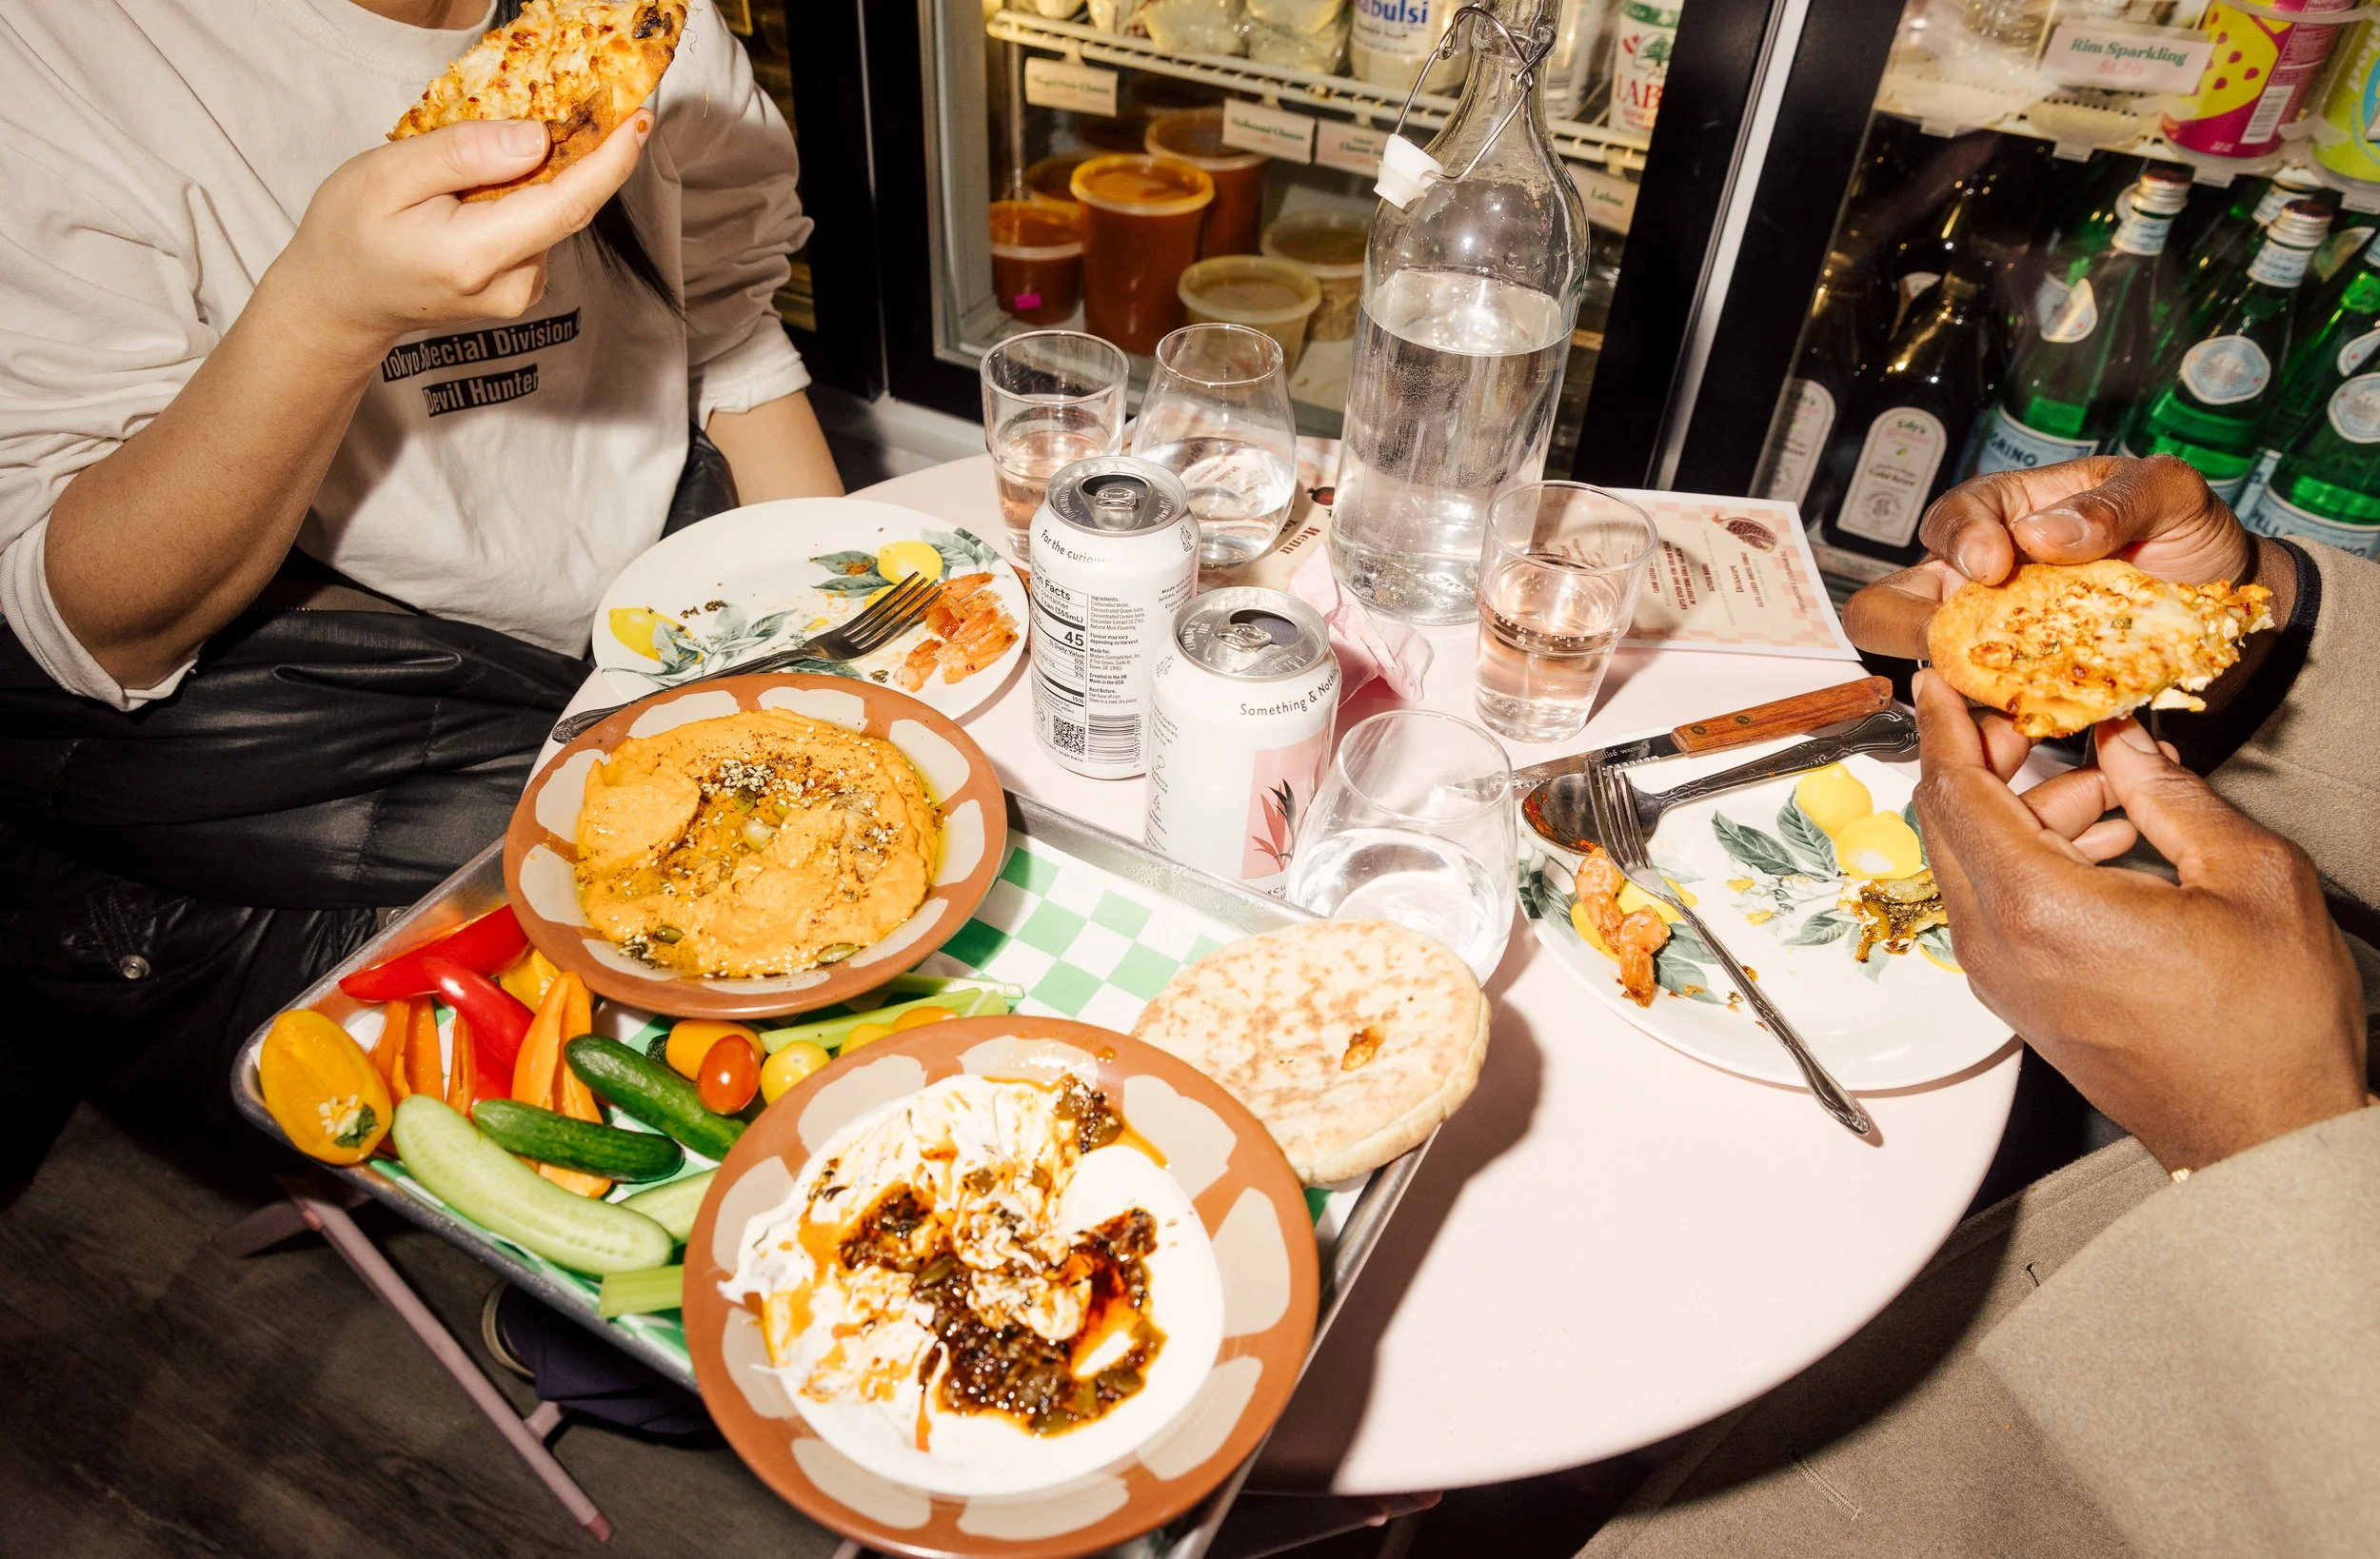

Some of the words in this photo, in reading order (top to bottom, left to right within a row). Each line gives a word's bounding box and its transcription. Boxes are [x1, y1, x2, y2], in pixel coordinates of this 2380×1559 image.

[1358, 0, 1428, 23] abulsi
[2071, 38, 2103, 53] Rim
[2106, 42, 2189, 67] Sparkling
[384, 348, 420, 379] Tokyo
[492, 319, 573, 356] Division
[424, 383, 466, 415] Devil
[468, 369, 539, 405] Hunter
[1041, 529, 1052, 545] For
[1052, 541, 1065, 555] the
[1045, 579, 1070, 601] Facts
[1055, 606, 1083, 623] (355mL)
[1054, 642, 1067, 654] Daily
[1068, 649, 1084, 659] Value
[1064, 631, 1084, 647] 45
[1240, 699, 1308, 716] Something
[1308, 690, 1318, 703] &
[1318, 667, 1340, 697] Nothin
